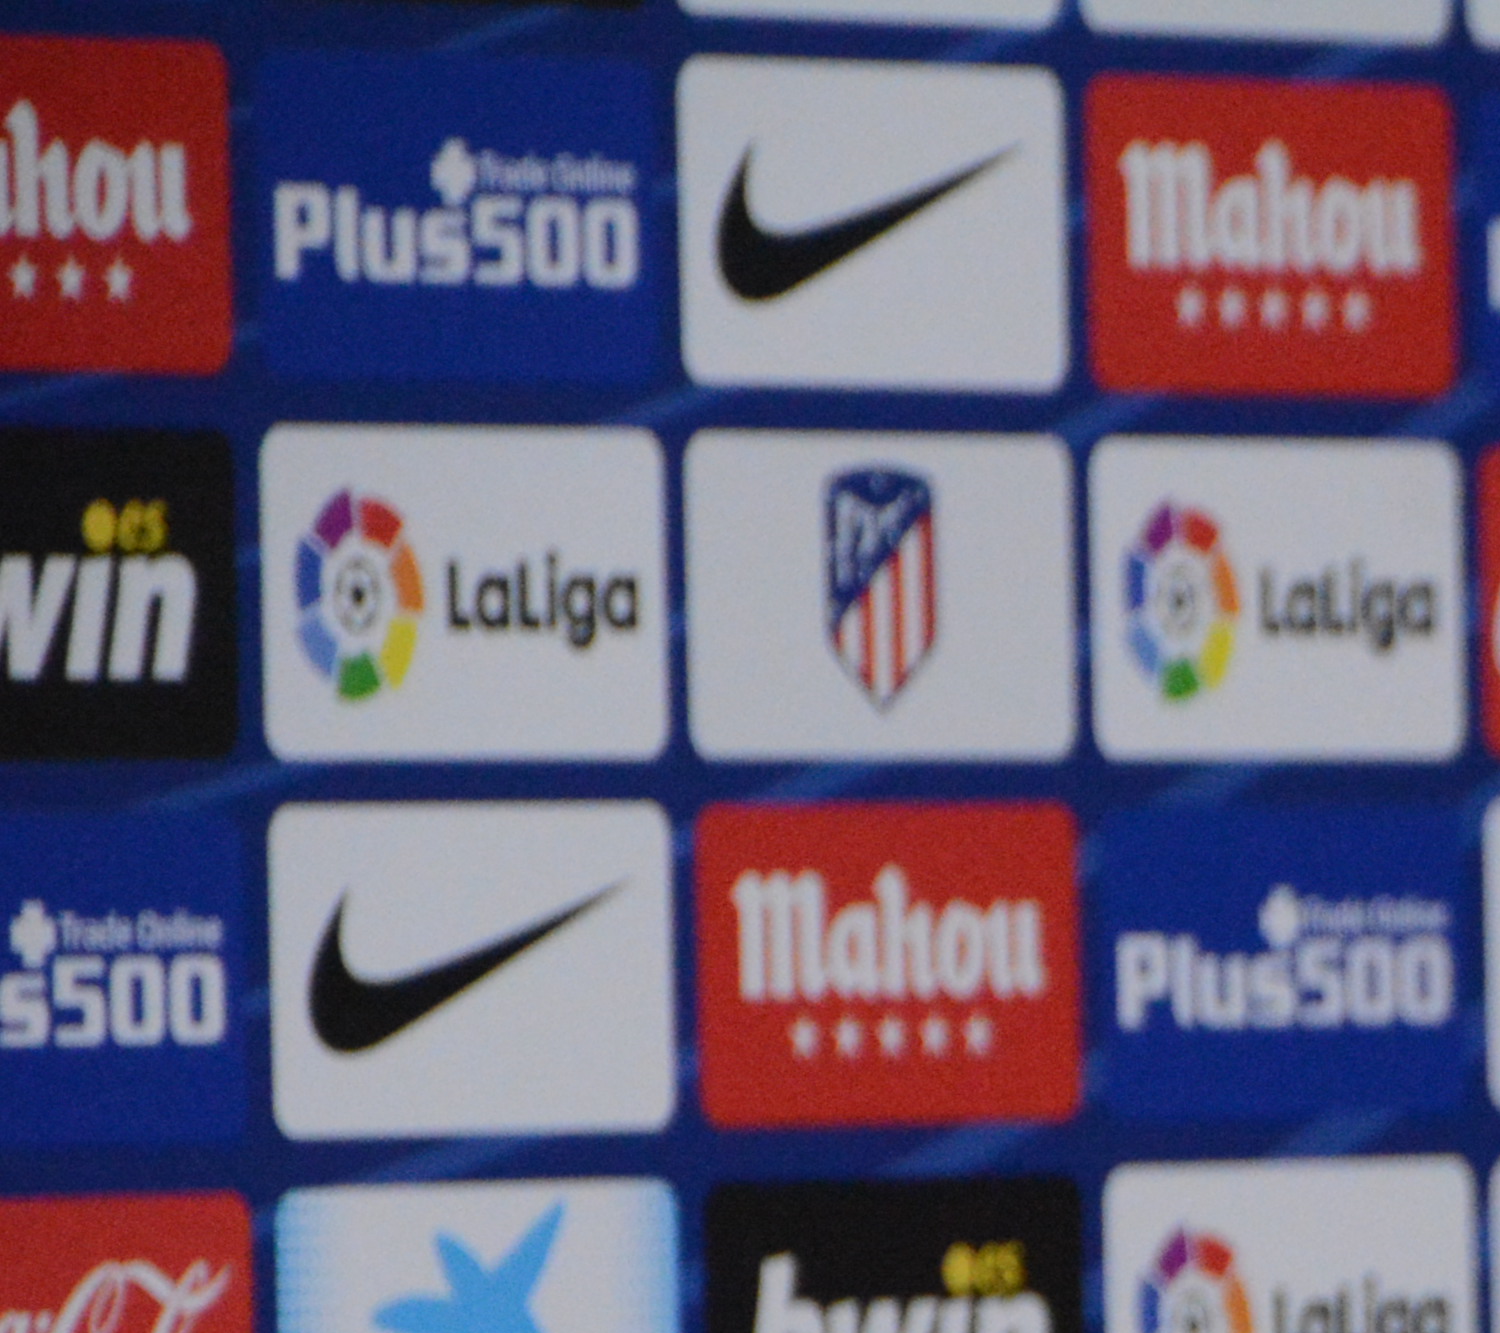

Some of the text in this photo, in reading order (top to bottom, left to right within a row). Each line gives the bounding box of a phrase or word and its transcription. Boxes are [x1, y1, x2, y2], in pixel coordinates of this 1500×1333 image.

[0, 101, 191, 242] hou
[1120, 141, 1421, 275] Mahou
[274, 181, 639, 289] Plus500
[0, 552, 197, 681] win
[448, 554, 639, 651] LaLiga
[1258, 555, 1437, 656] LaLiga
[732, 865, 1045, 1000] Mahou
[1116, 932, 1453, 1030] Plus500
